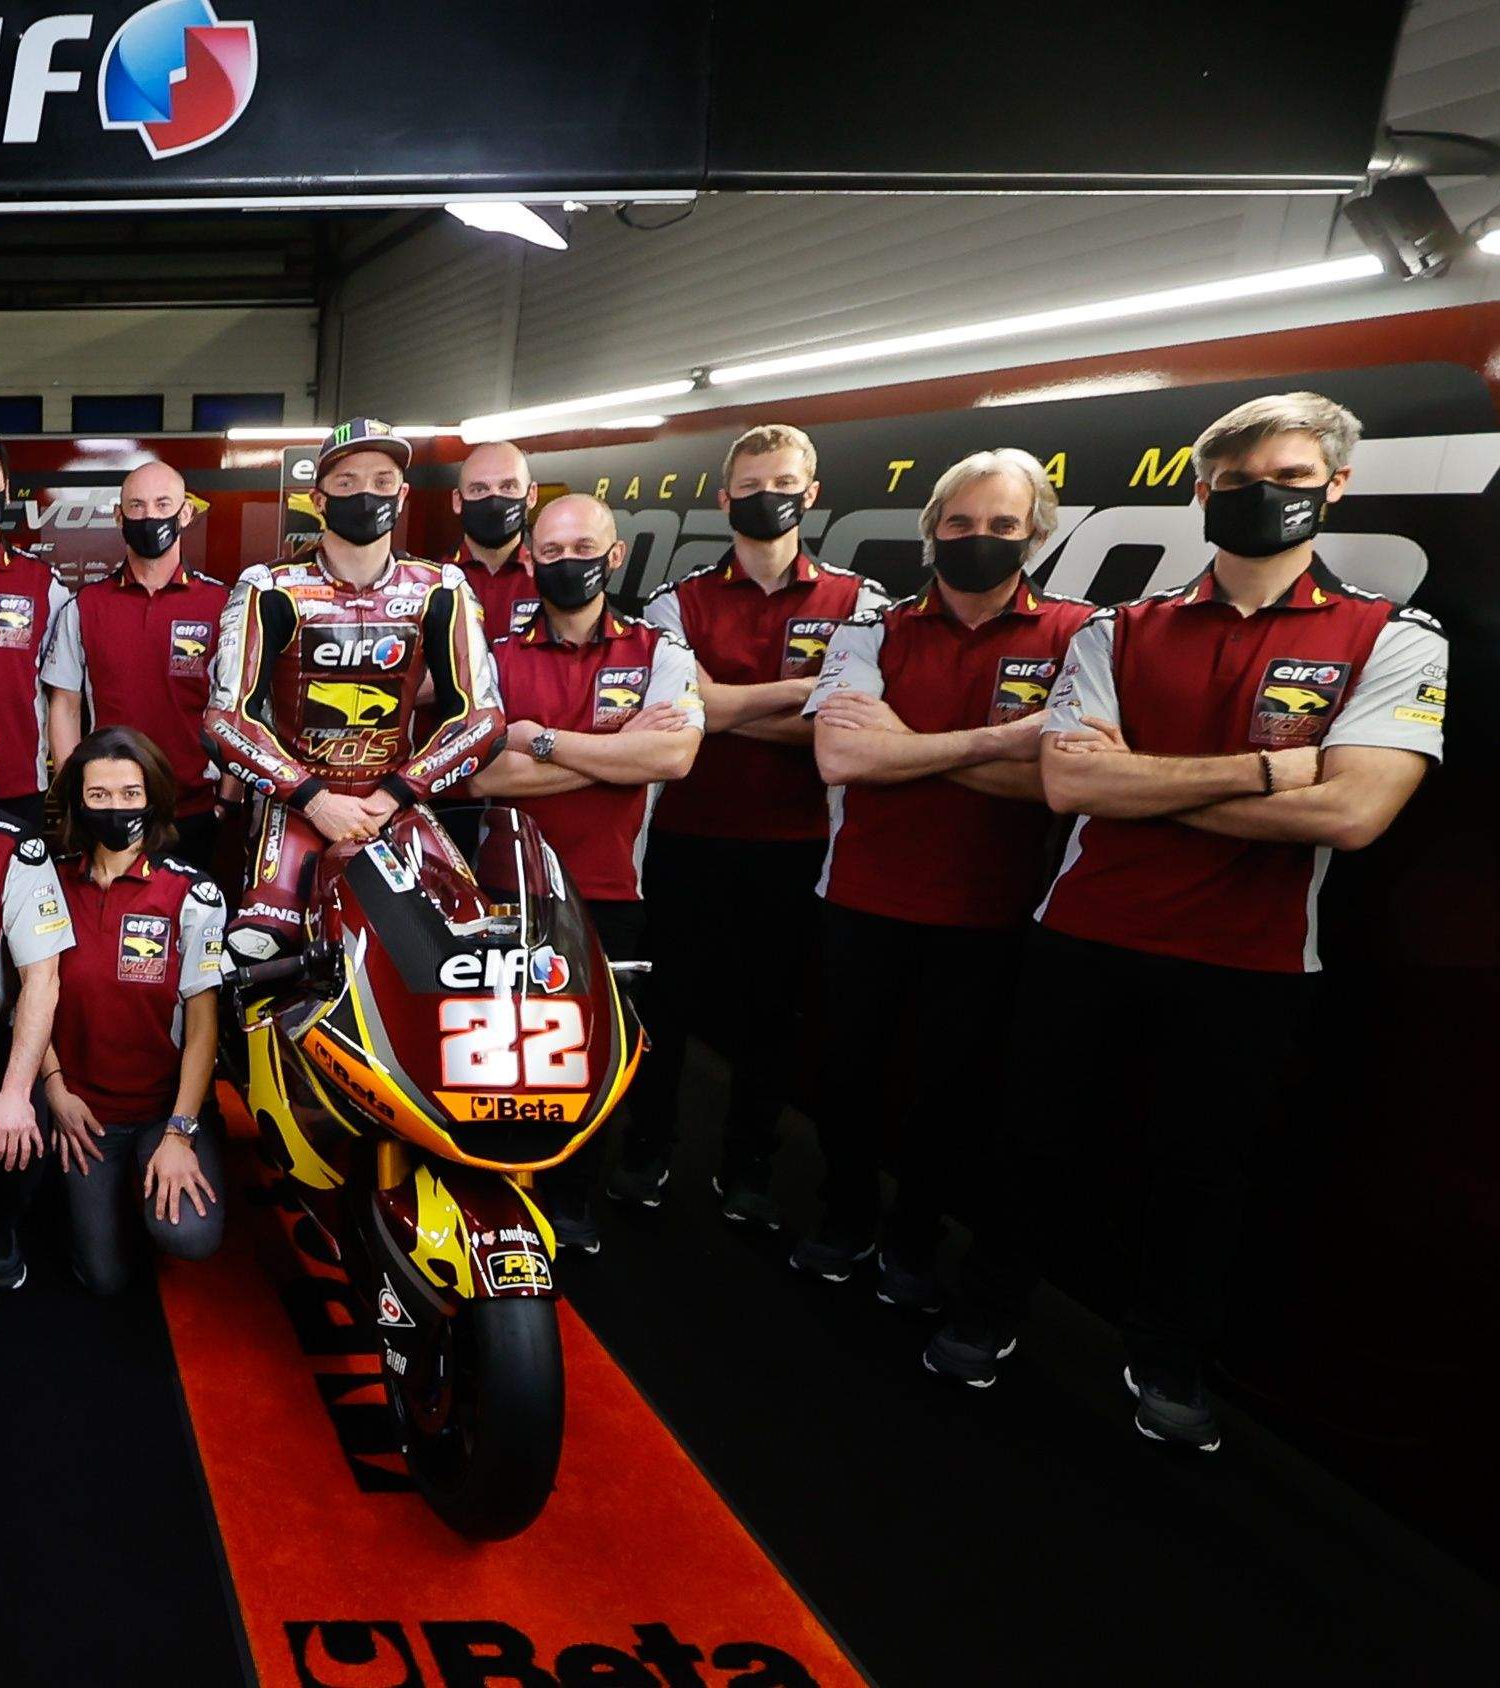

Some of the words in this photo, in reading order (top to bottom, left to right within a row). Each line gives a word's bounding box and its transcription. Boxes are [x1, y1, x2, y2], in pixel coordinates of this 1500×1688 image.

[313, 641, 373, 666] elf
[1005, 664, 1038, 676] elf
[1273, 666, 1313, 681] elf
[442, 951, 528, 988] elf
[439, 998, 591, 1088] 22
[499, 1096, 565, 1121] Beta
